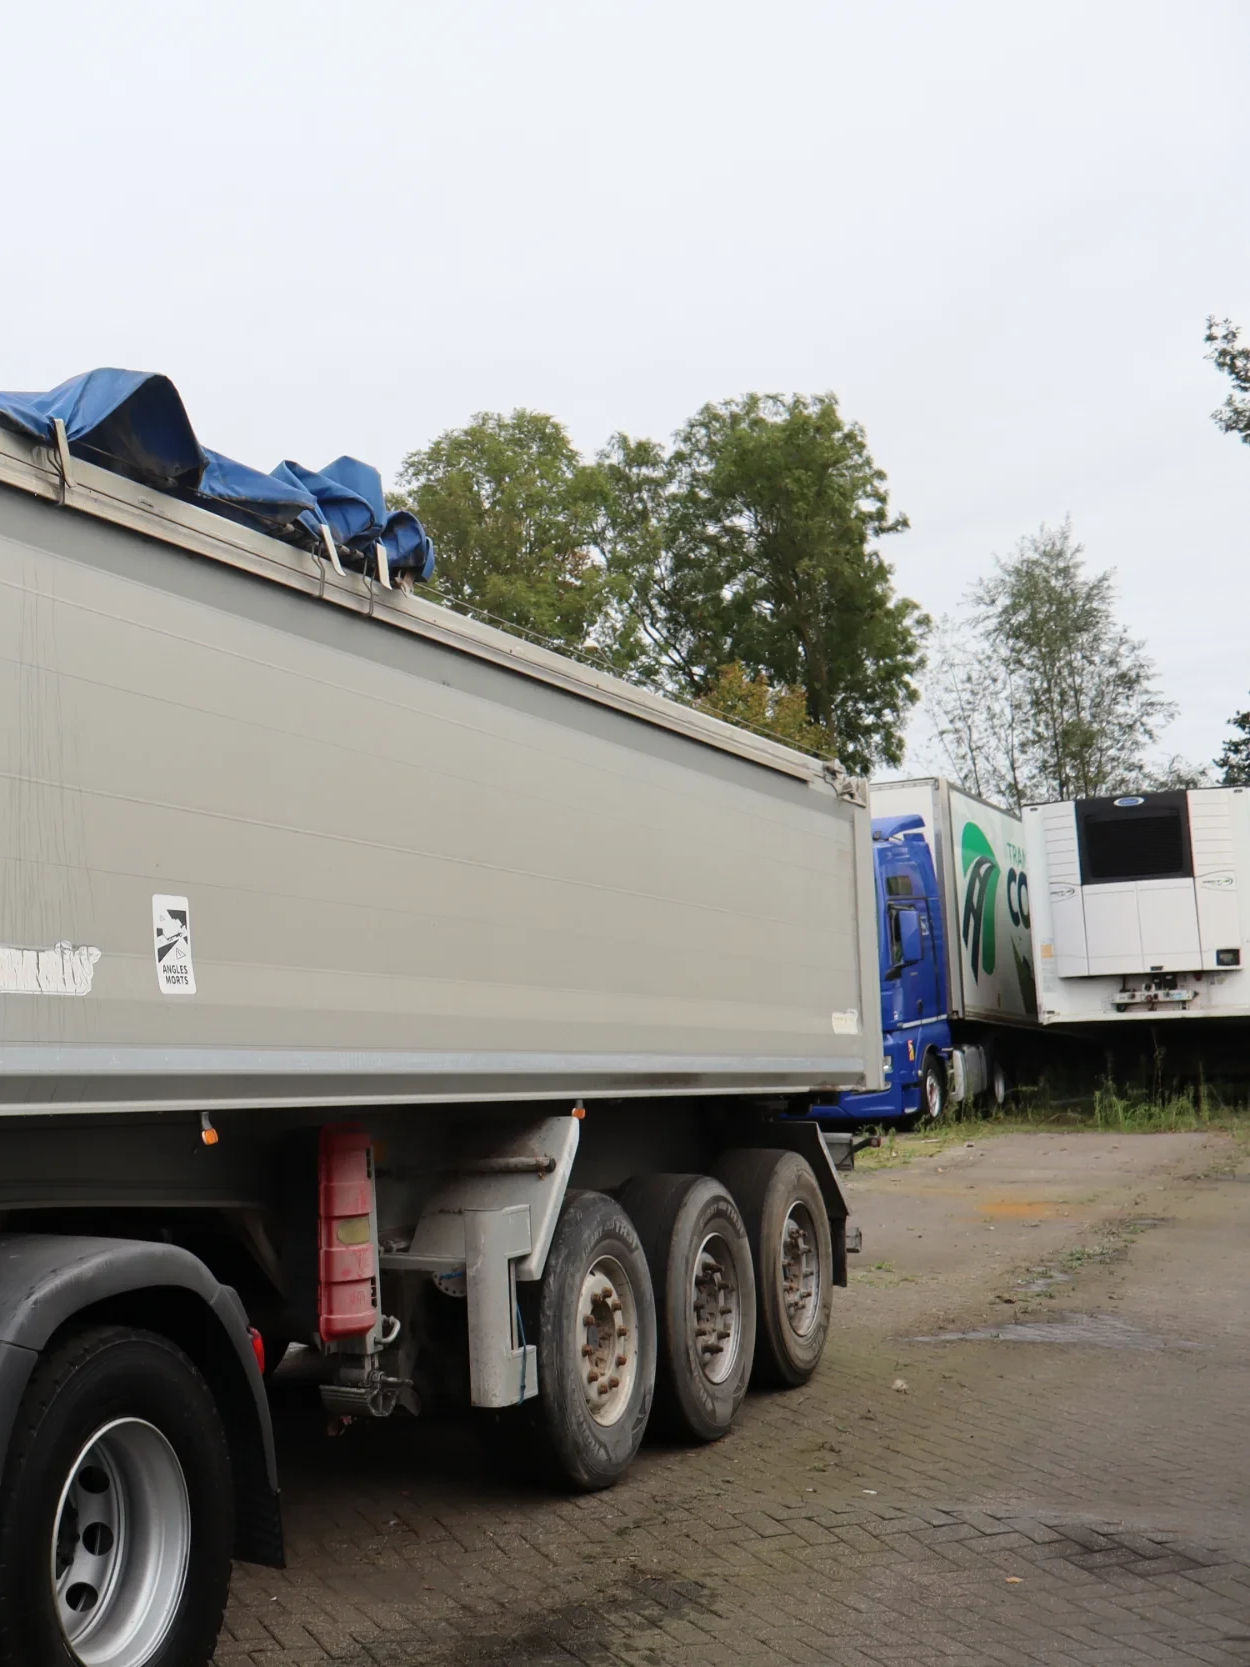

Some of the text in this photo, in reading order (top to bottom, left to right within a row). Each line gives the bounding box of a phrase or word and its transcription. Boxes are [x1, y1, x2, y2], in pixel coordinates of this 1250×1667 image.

[1007, 867, 1031, 930] CO
[162, 964, 189, 975] ANGLES
[165, 975, 189, 985] MORTS
